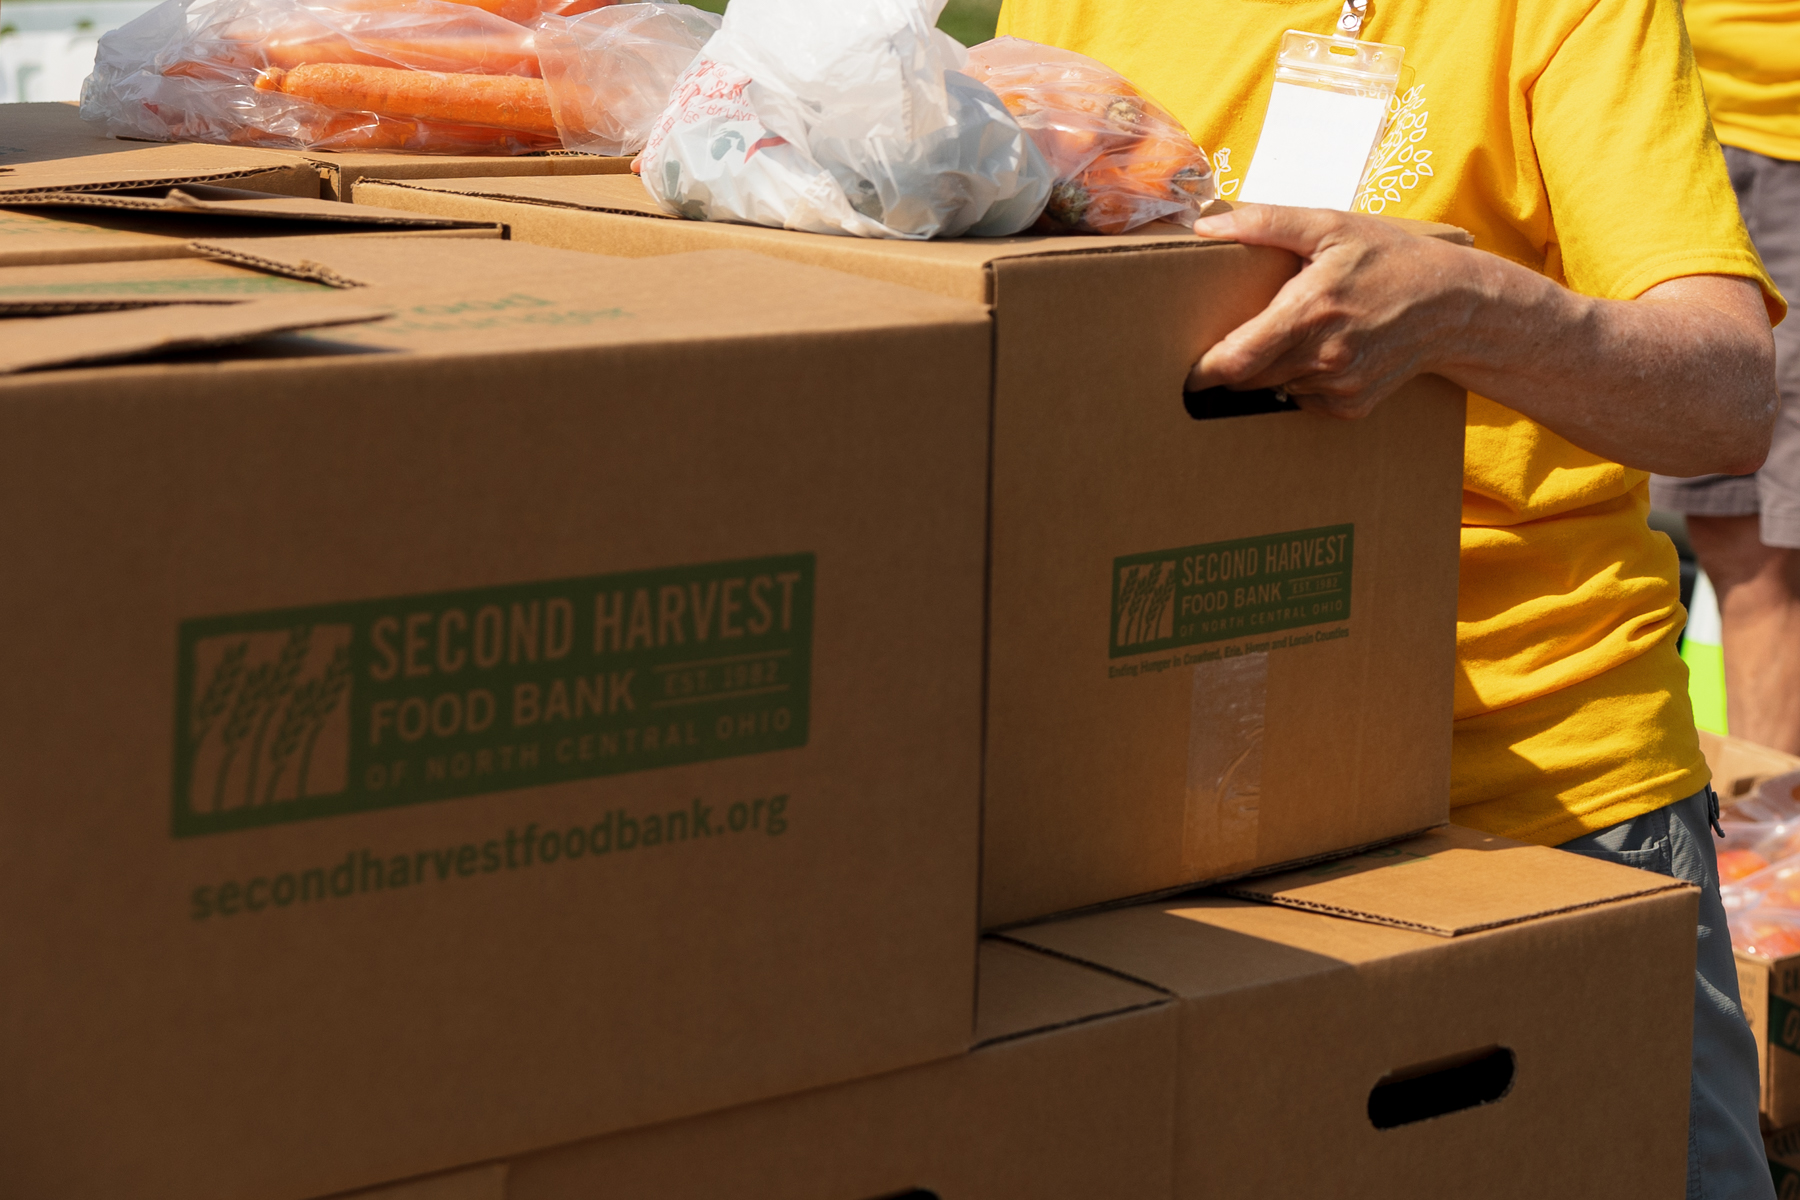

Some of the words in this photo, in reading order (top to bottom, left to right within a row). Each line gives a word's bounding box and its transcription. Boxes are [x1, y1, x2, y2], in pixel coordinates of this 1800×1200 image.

[1182, 547, 1259, 587] SECOND
[1265, 533, 1347, 574] HARVEST
[1316, 576, 1338, 590] 1982
[1180, 624, 1195, 637] OF
[1202, 616, 1245, 633] NORTH
[1250, 605, 1307, 626] CENTRAL
[1313, 599, 1343, 615] OHIO
[1181, 590, 1229, 616] FOOD
[1234, 581, 1282, 608] BANK
[369, 597, 574, 682] SECOND
[594, 570, 801, 657] HARVEST
[1108, 663, 1138, 678] Ending
[1140, 657, 1171, 673] Hunger
[1272, 637, 1287, 651] and
[1289, 632, 1313, 648] Lorain
[1315, 626, 1349, 644] Counties
[370, 689, 498, 748] FOOD
[512, 668, 639, 727] BANK
[664, 666, 712, 698] EST.
[365, 758, 409, 794] OF
[425, 743, 541, 782] NORTH
[555, 721, 699, 766] CENTRAL
[715, 706, 792, 742] OHIO
[190, 793, 791, 922] secondharvestfoodbank.org
